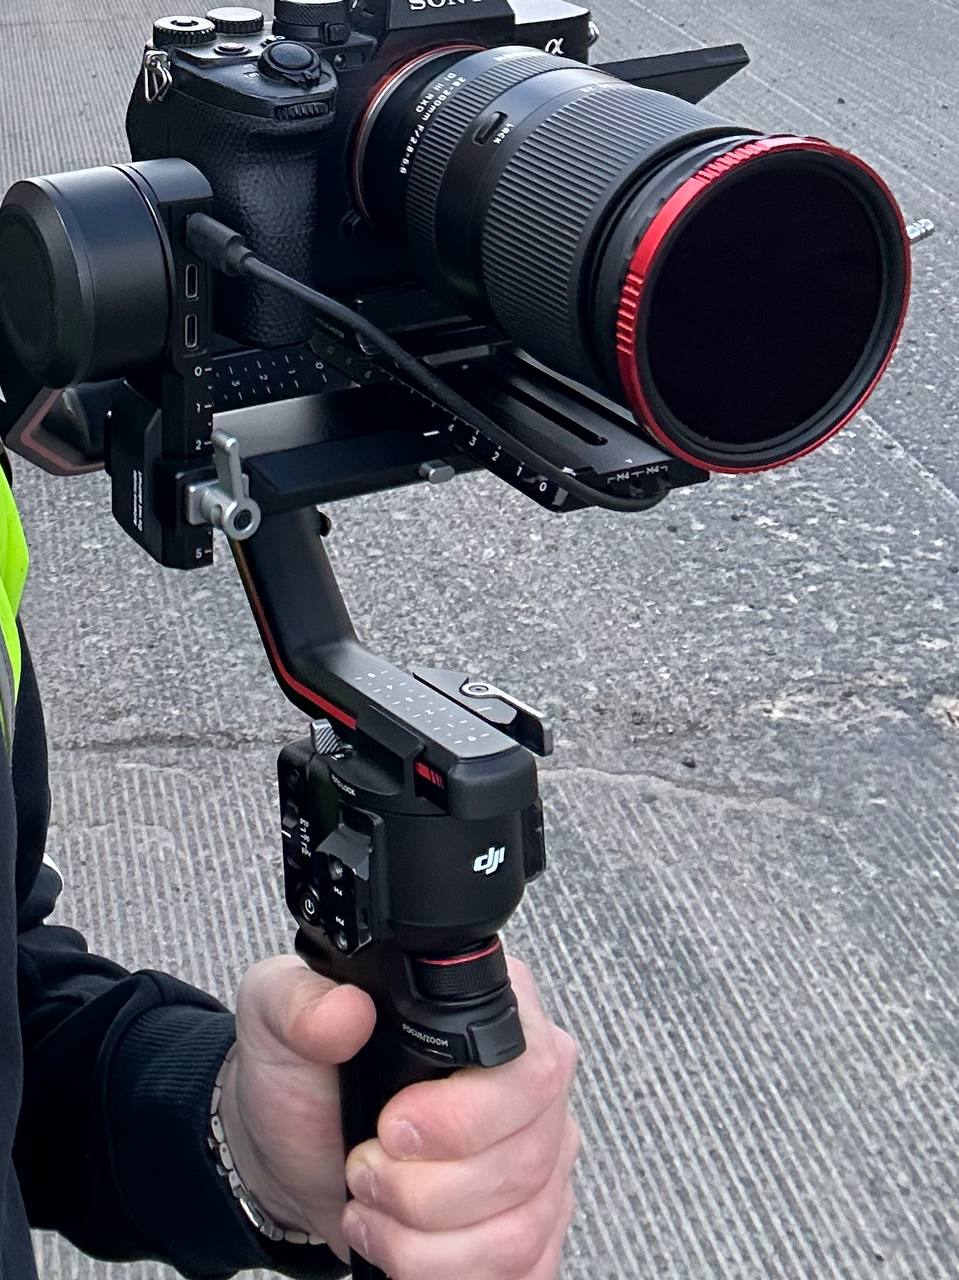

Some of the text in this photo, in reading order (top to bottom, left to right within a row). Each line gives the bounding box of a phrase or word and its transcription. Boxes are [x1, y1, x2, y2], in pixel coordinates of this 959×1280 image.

[415, 92, 435, 113] RXD
[195, 439, 202, 451] 2
[468, 435, 477, 447] 3
[491, 450, 500, 461] 2
[539, 481, 547, 492] 0
